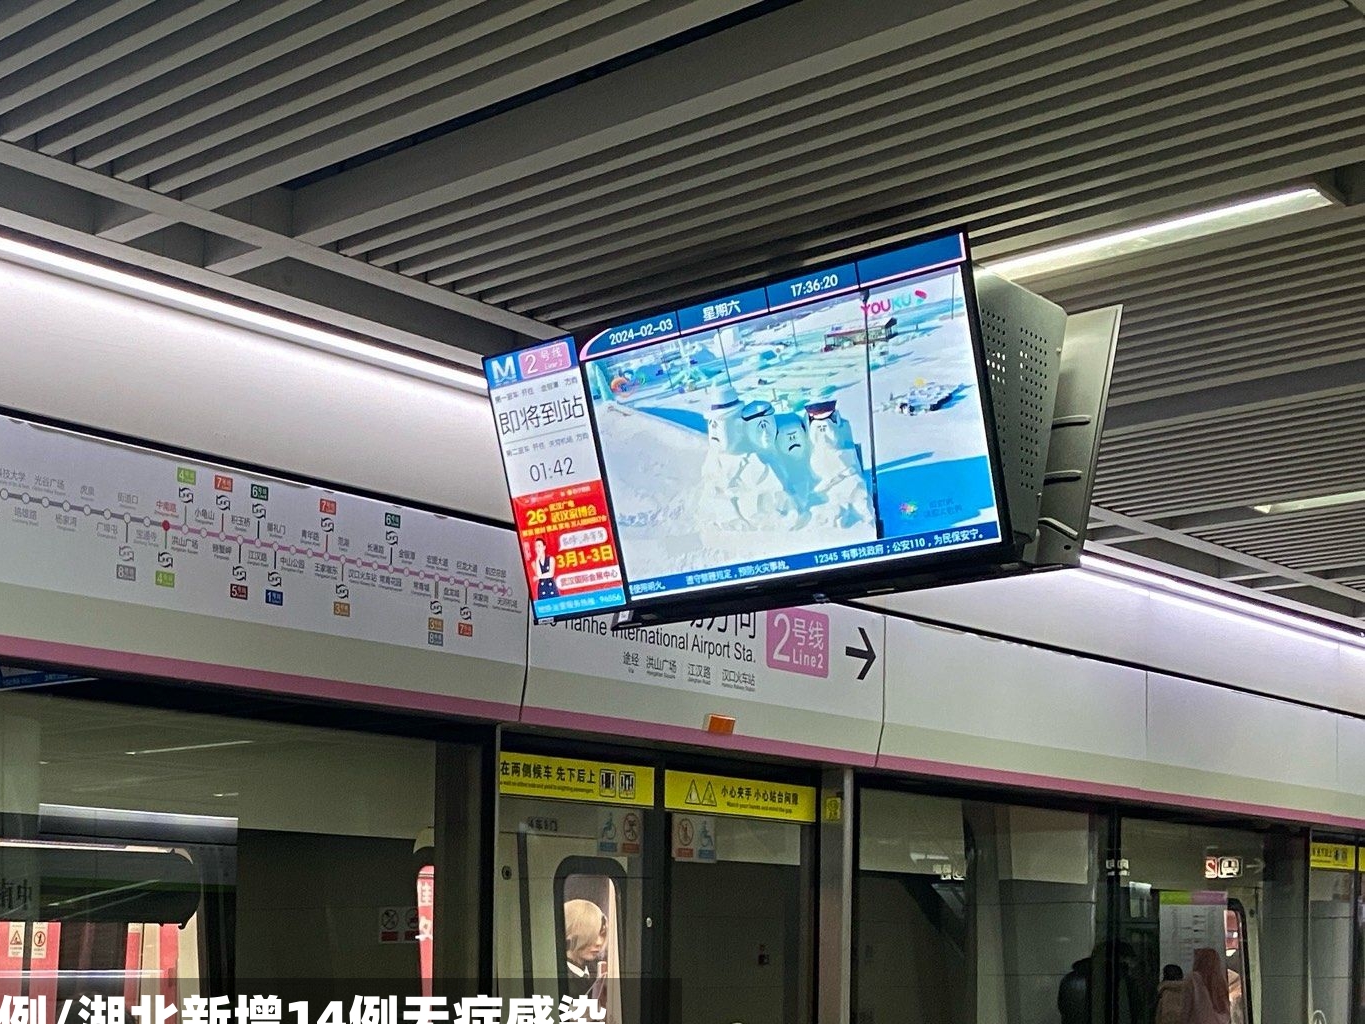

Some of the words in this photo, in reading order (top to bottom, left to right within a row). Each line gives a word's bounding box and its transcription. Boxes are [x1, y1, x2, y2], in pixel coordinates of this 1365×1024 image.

[790, 273, 839, 298] 17:36:20
[702, 299, 741, 323] 星期六
[860, 291, 912, 317] YOUKU
[609, 318, 674, 346] 2024-02-03
[499, 395, 584, 436] 即将到站
[530, 457, 575, 482] 01:42
[556, 545, 614, 569] 3月1-3日
[814, 553, 838, 564] 12345
[623, 652, 639, 666] 途经
[691, 634, 731, 659] Airport
[734, 642, 756, 663] Sta.
[646, 656, 676, 673] 洪山广场
[688, 663, 711, 679] 江汉路
[722, 669, 755, 686] 汉口火车站
[501, 760, 552, 780] 在两侧候车
[556, 766, 596, 784] 先下后上
[721, 786, 752, 800] 小心夹手
